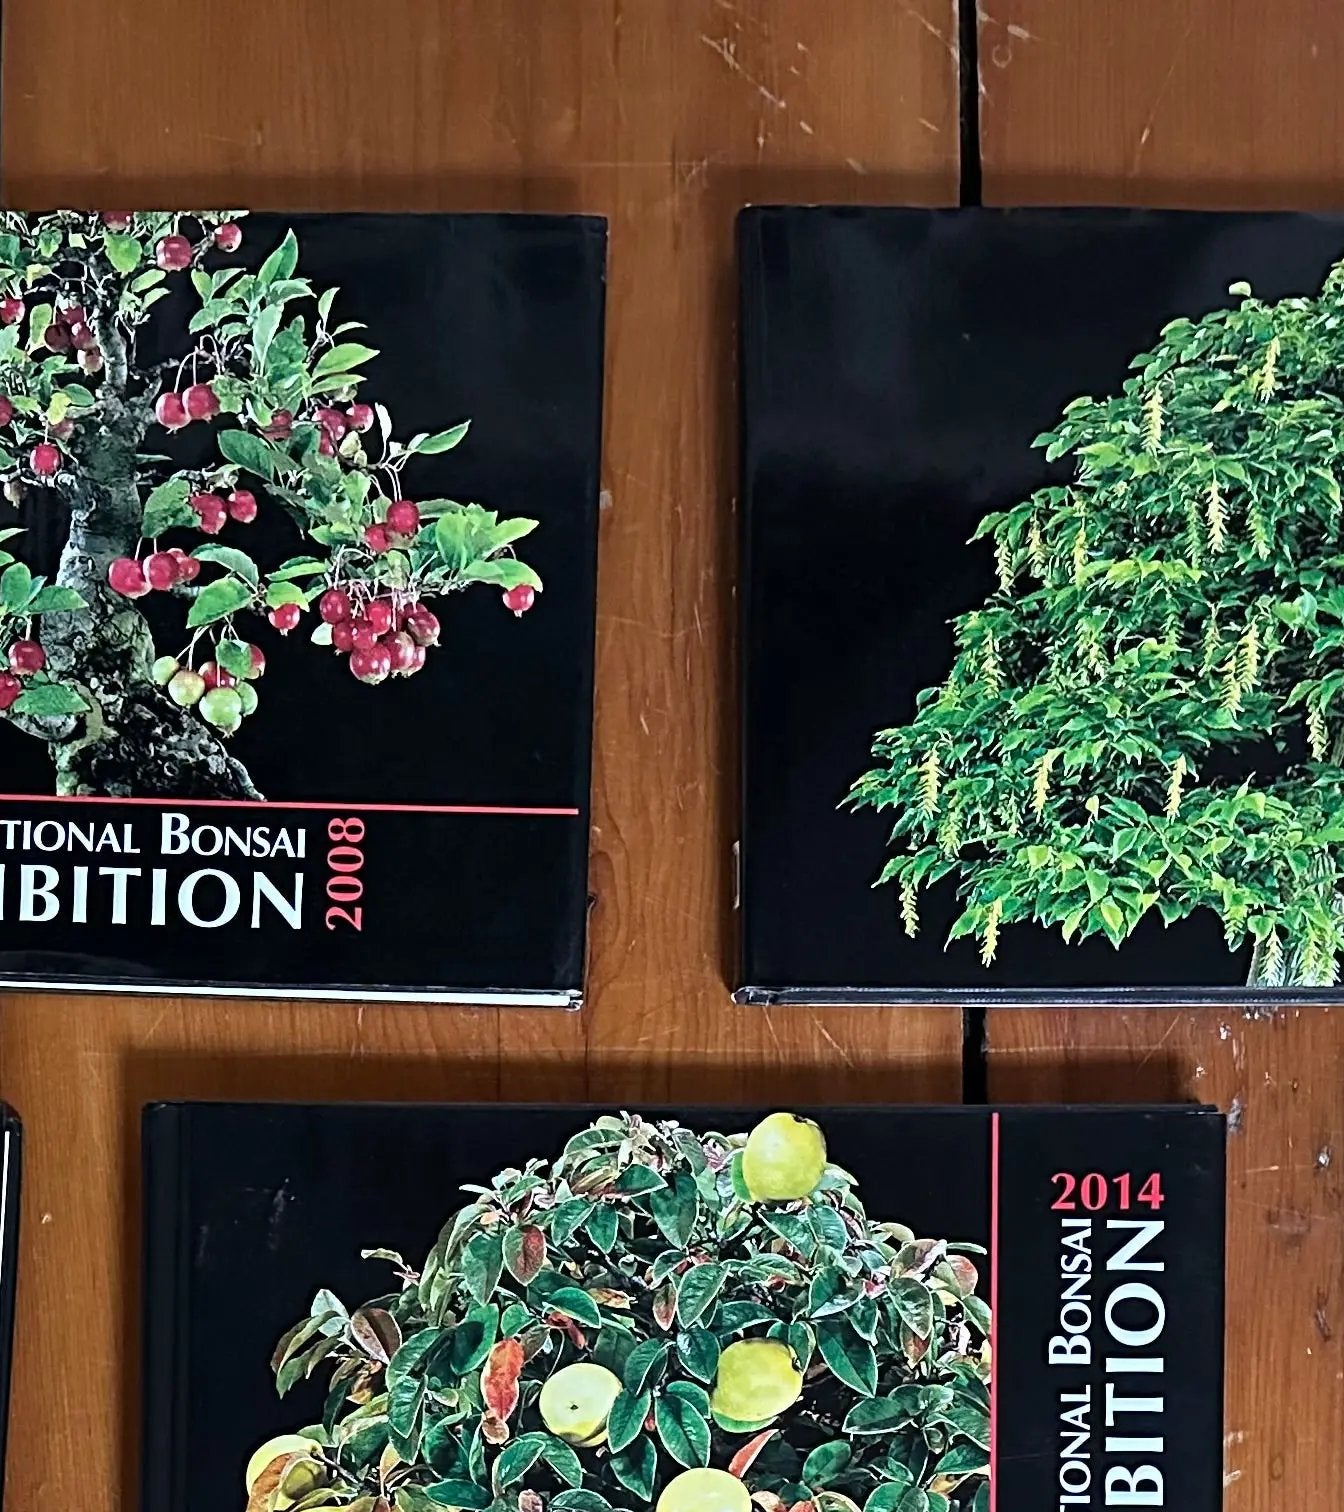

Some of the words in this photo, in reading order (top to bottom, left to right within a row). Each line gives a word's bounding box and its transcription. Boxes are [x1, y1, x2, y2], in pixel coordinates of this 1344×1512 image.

[160, 812, 307, 860] BONSAI
[325, 816, 365, 931] 2008
[1051, 1172, 1165, 1210] 2014
[1048, 1218, 1092, 1365] BONSAI
